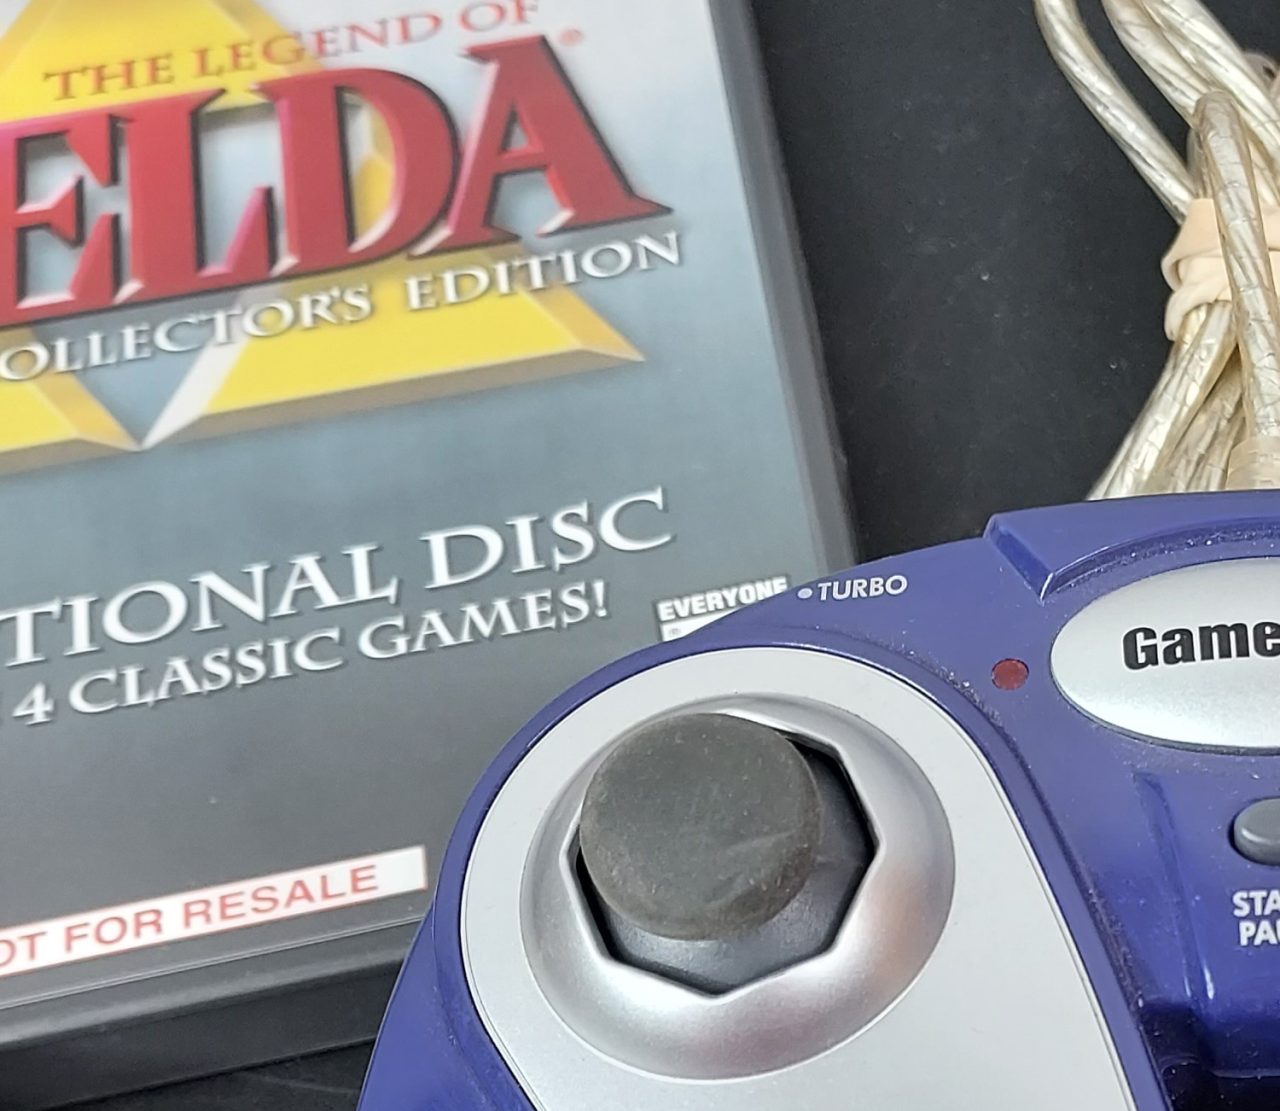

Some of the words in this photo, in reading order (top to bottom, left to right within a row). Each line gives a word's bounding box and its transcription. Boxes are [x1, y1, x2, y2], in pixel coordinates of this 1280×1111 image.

[43, 51, 173, 100] THE
[191, 11, 441, 77] LEGEND
[459, 0, 540, 33] OF
[0, 284, 373, 382] OLLECTOR'S
[405, 230, 682, 311] EDITION
[0, 542, 399, 668] TIONAL
[420, 487, 673, 590] DISC
[657, 576, 788, 622] EVERYONE
[817, 574, 908, 601] TURBO
[11, 682, 56, 727] 4
[69, 627, 346, 714] CLASSIC
[357, 580, 609, 660] GAMES!
[64, 907, 163, 953] FOR
[182, 864, 379, 928] RESALE
